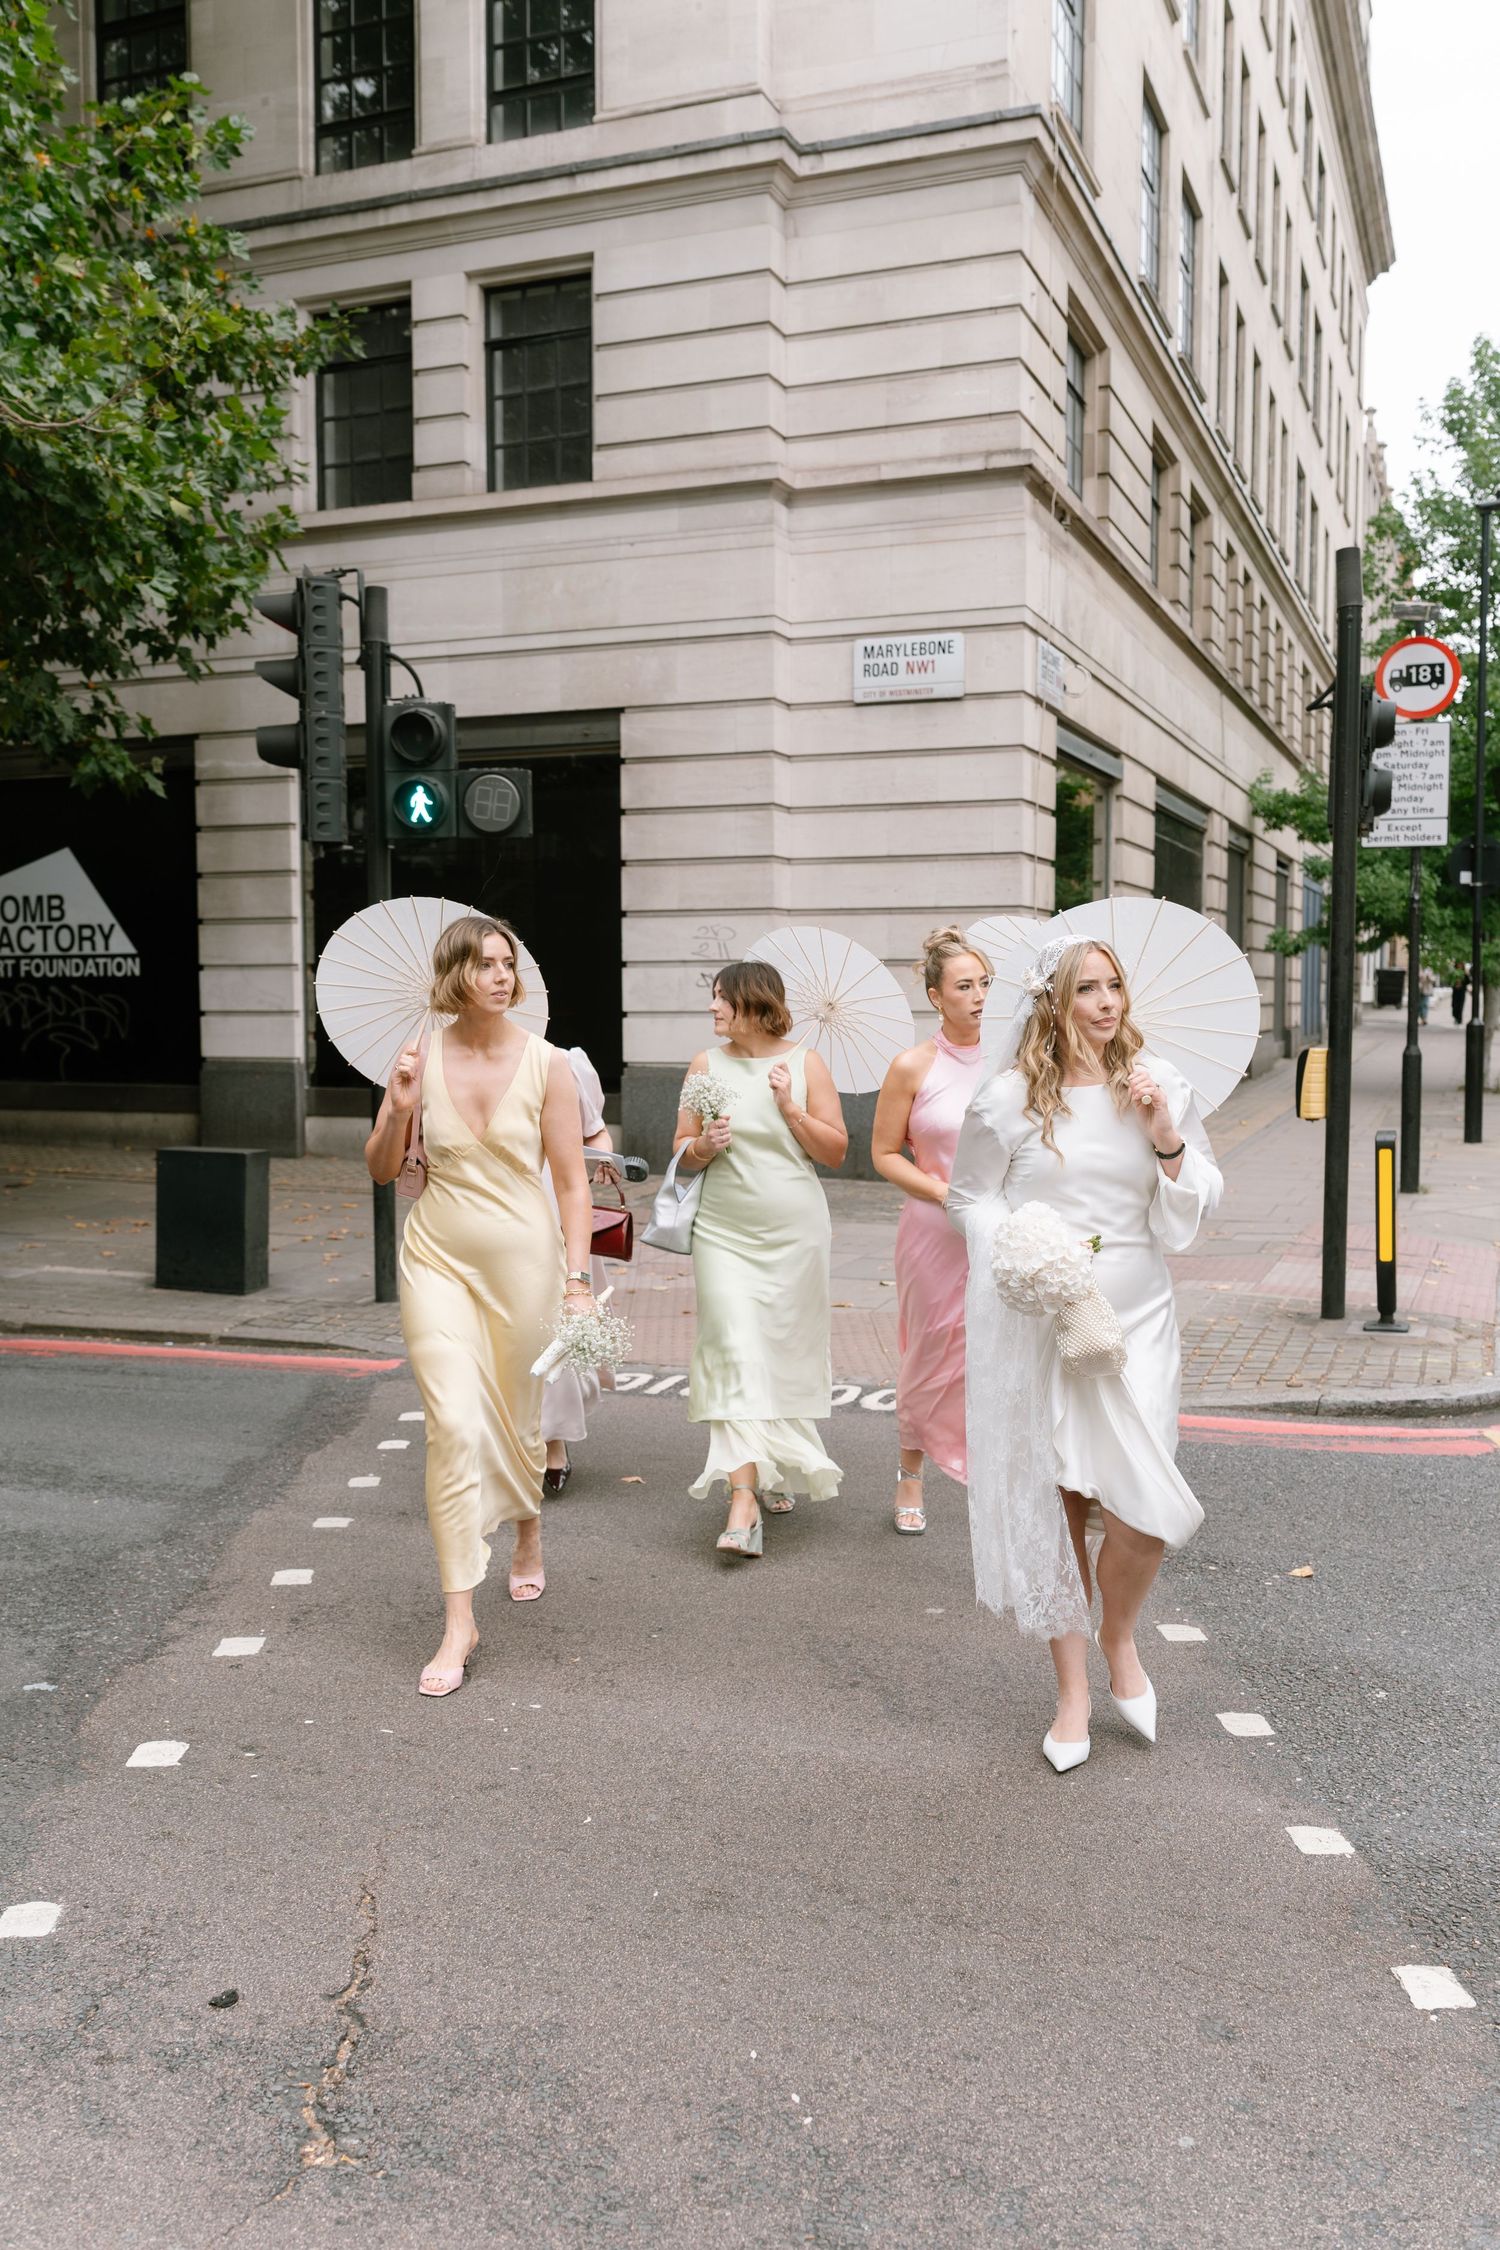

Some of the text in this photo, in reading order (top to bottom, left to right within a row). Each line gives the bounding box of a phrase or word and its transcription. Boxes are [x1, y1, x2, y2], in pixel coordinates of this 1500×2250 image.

[863, 640, 955, 660] MARYLEBONE
[863, 659, 936, 678] ROAD NW1
[1415, 727, 1429, 736] Fri
[1400, 749, 1445, 759] Midnight
[1383, 761, 1430, 770] Saturday
[1398, 783, 1444, 793] Midnight
[1394, 795, 1425, 804] unday
[1391, 805, 1435, 816] any time
[1387, 823, 1422, 833] Except
[1367, 832, 1442, 843] permit holders
[0, 894, 66, 924] OMB
[0, 923, 115, 953] ACTORY
[20, 956, 140, 978] FOUNDATION
